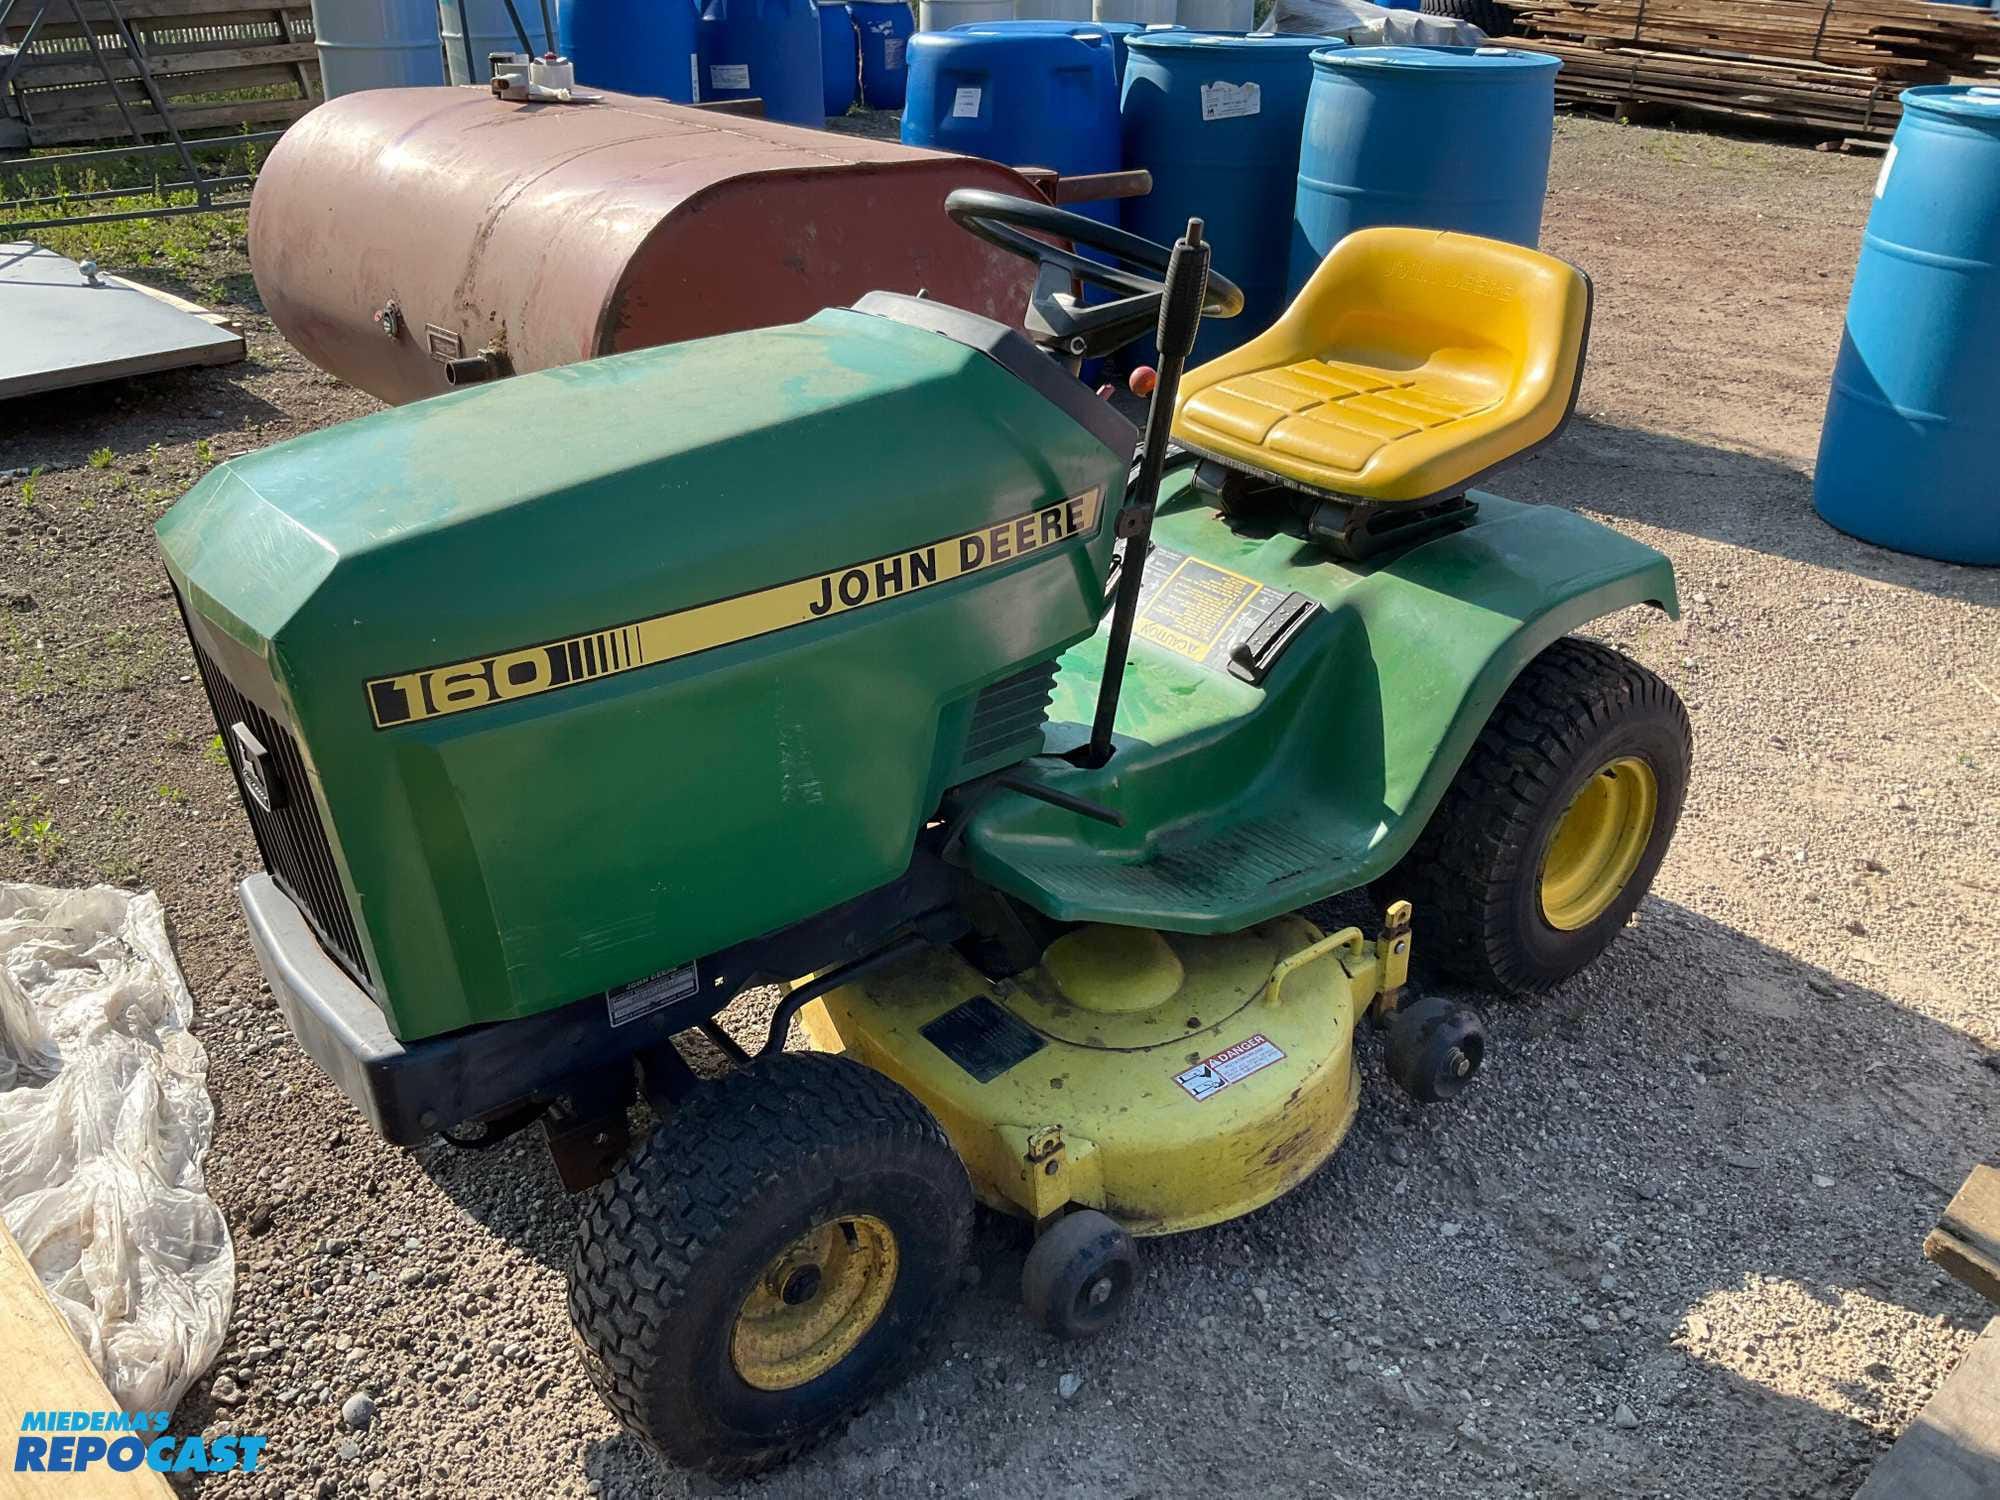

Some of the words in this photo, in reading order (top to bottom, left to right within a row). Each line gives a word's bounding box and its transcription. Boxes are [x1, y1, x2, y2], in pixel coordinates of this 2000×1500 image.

[809, 548, 937, 616] JOHN
[959, 496, 1085, 573] DEERE
[392, 648, 552, 720] 160
[1217, 1035, 1265, 1062] DANGER
